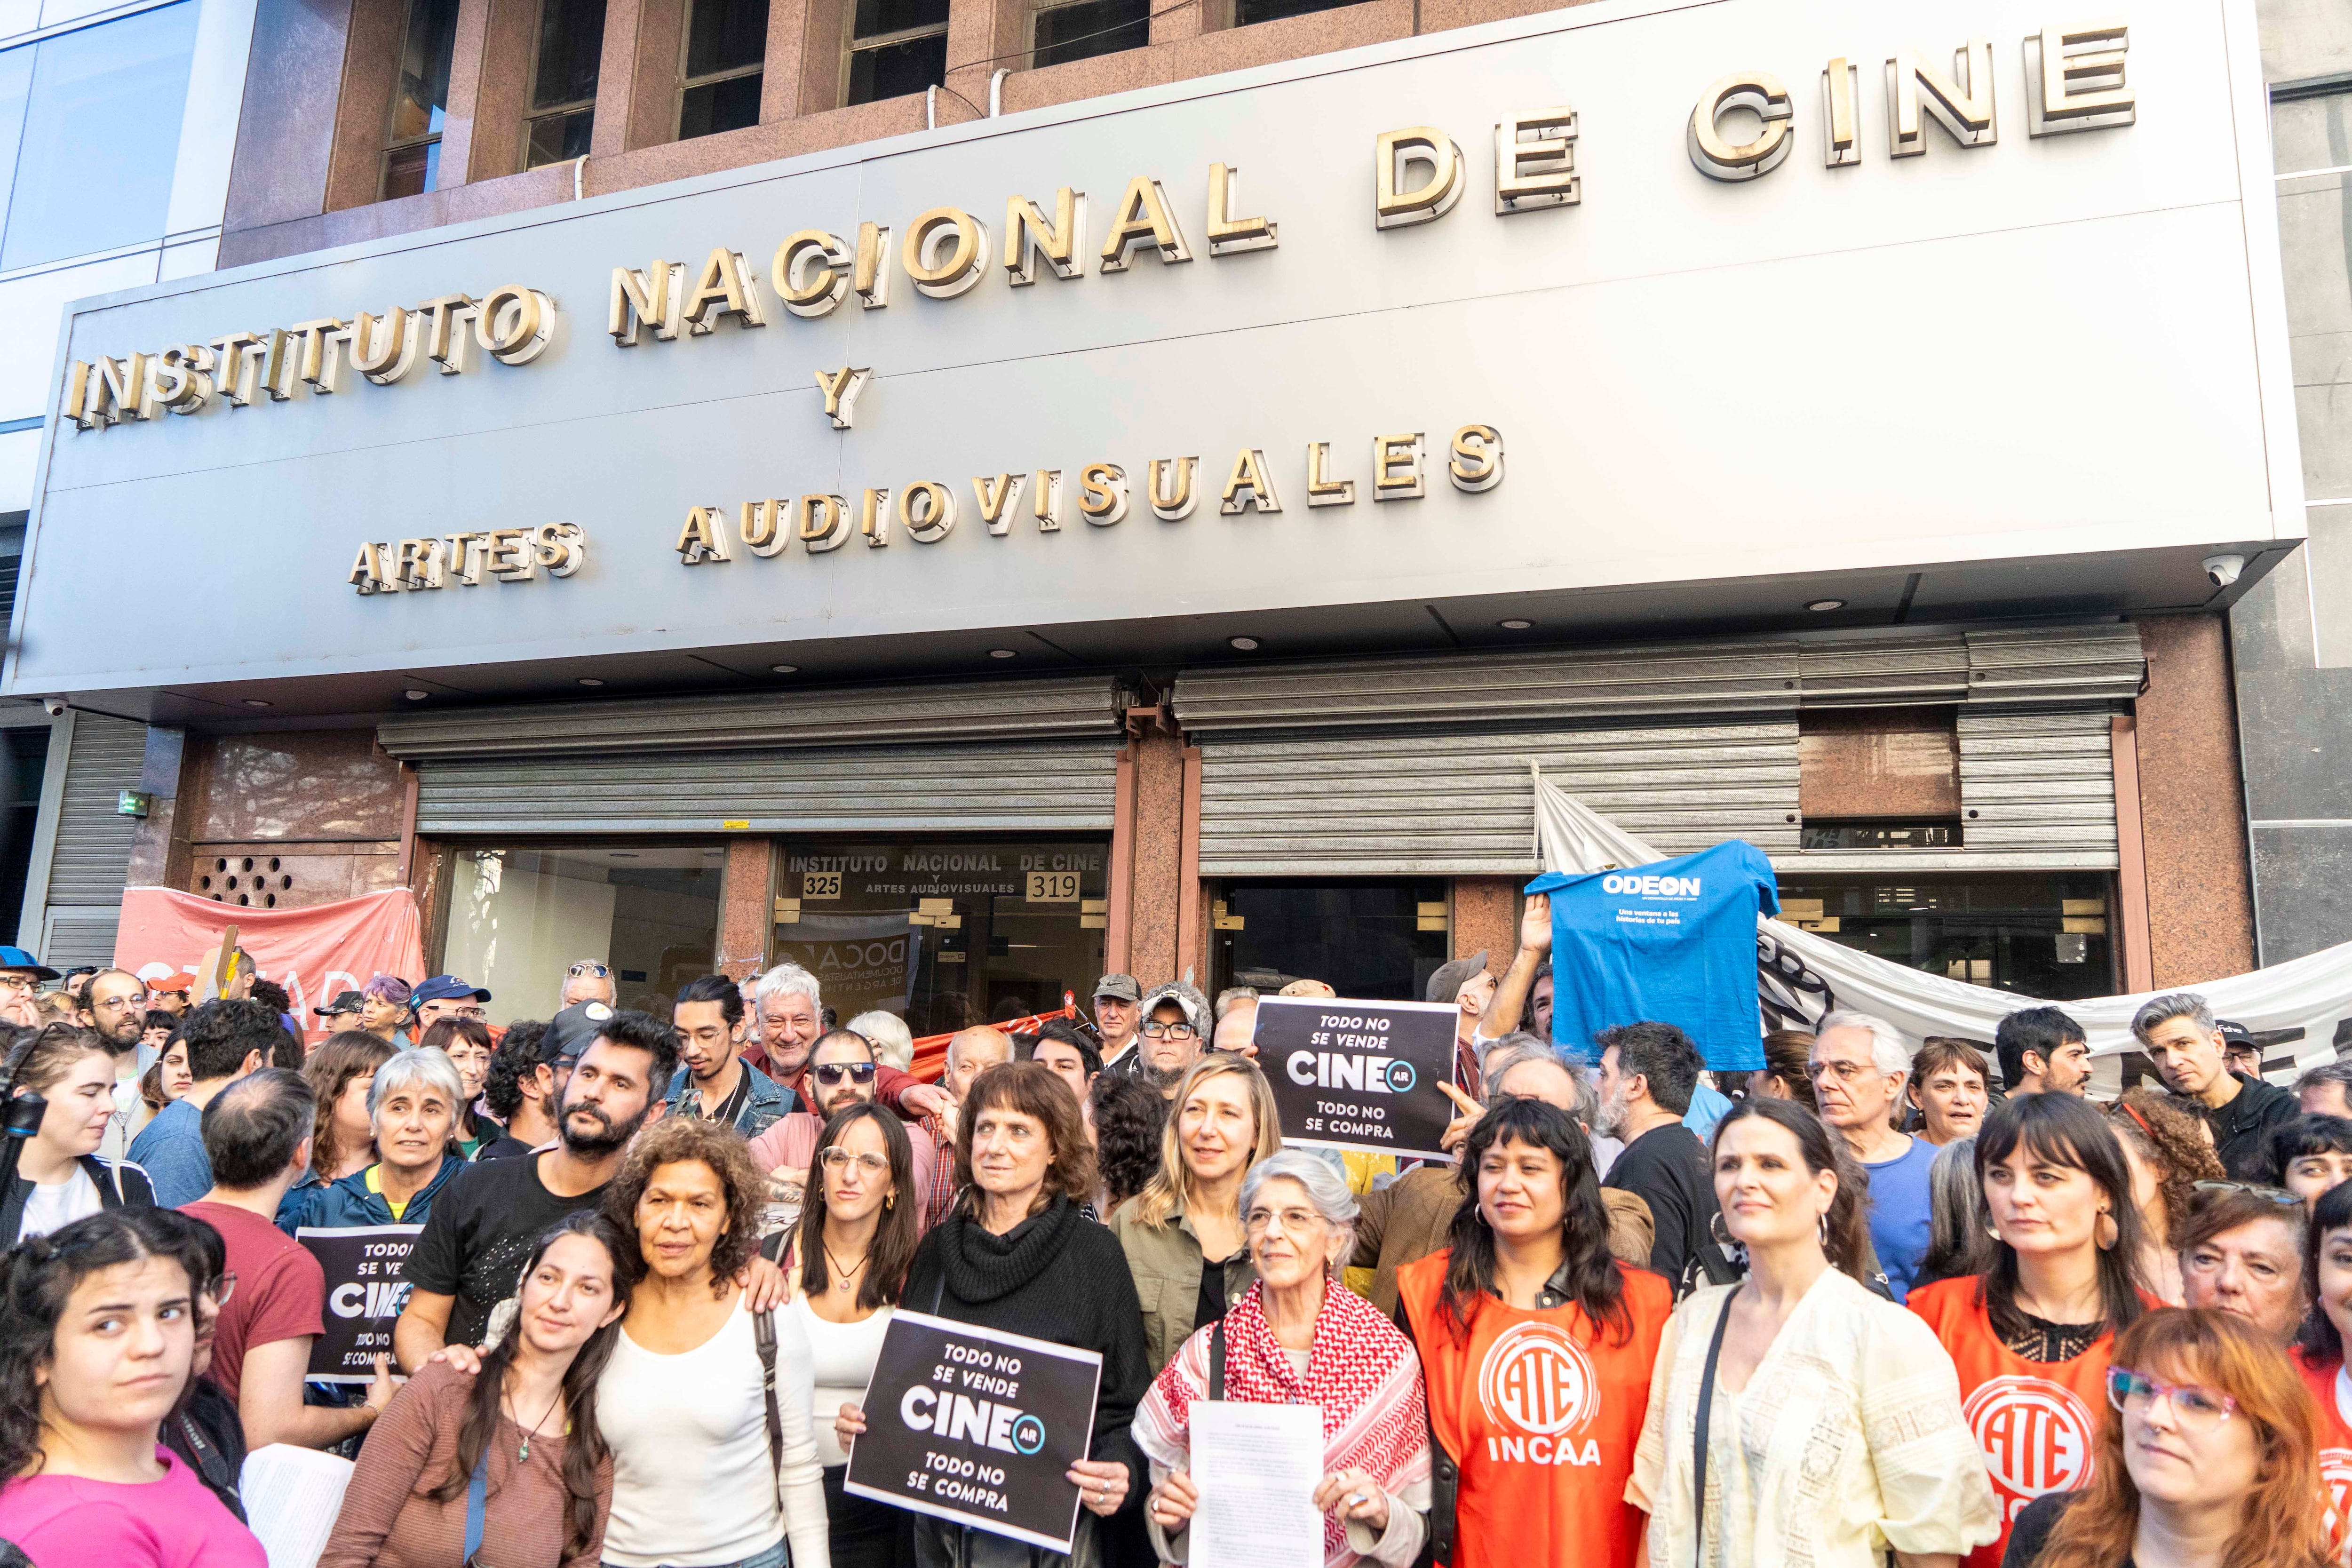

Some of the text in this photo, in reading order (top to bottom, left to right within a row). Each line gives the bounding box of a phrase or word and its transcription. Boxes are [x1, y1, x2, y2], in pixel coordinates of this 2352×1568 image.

[64, 24, 2136, 429] INSTITUTO NACIONAL DE CINE
[814, 367, 873, 429] Y
[347, 424, 1505, 595] ARTES AUDIOVISUALES
[790, 854, 1100, 873] INSTITUTO NACIONAL DE CINE
[805, 876, 839, 895] 325
[866, 883, 1014, 894] ARTES AUDIOVISUALES
[932, 875, 940, 883] Y
[1032, 875, 1076, 898] 319
[1603, 875, 1701, 896] ODEON
[1320, 1015, 1391, 1031] TODO NO
[2217, 1024, 2243, 1034] Fisher
[1311, 1032, 1389, 1050] SE VENDE
[1287, 1050, 1409, 1094] CINE AR
[1317, 1101, 1385, 1120] TODO NO
[1305, 1117, 1394, 1139] SE COMPRA
[364, 1243, 408, 1257] TODO
[357, 1262, 379, 1275] SE
[376, 1333, 390, 1346] NO
[351, 1352, 397, 1366] COMRA
[944, 1343, 1022, 1375] TODO NO
[932, 1364, 1019, 1399] SE VENDE
[1504, 1347, 1574, 1426] ATE
[900, 1385, 1037, 1454] CINE AR
[1487, 1436, 1601, 1466] INCAA
[1984, 1402, 2072, 1490] ATE
[926, 1451, 1005, 1485] TODO NO
[907, 1471, 1008, 1512] SE COMPRA
